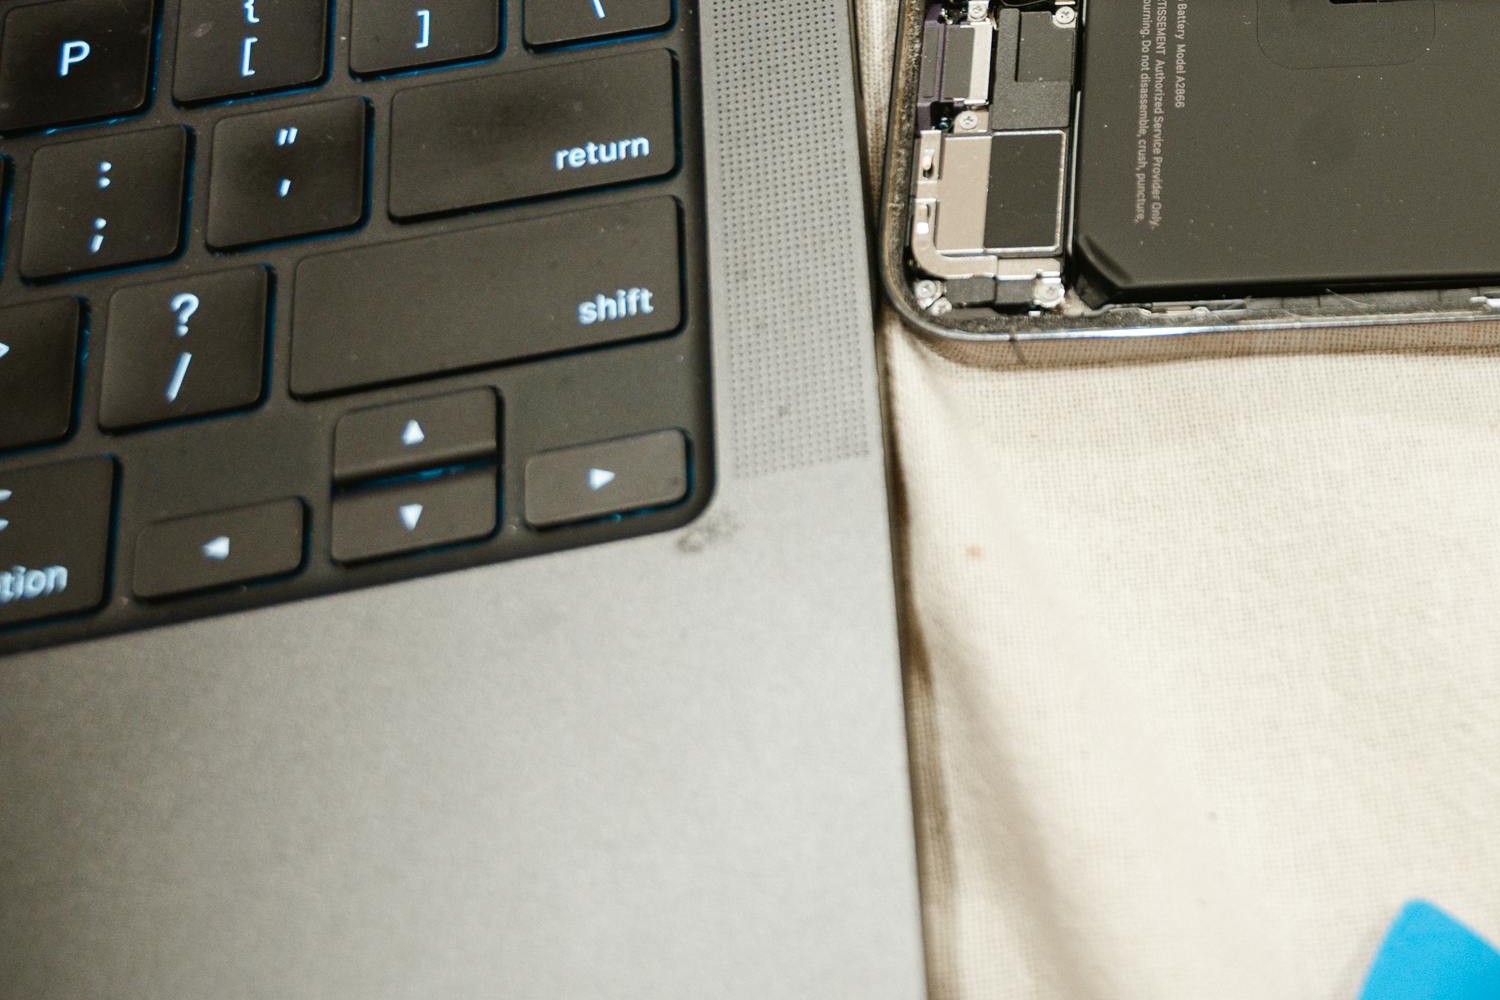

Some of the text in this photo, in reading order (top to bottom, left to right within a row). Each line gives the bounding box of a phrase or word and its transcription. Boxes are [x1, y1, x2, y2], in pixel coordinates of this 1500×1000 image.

[1174, 3, 1187, 40] Battery
[59, 40, 90, 77] P
[1140, 55, 1150, 71] not
[1141, 40, 1152, 53] Do
[1175, 44, 1187, 74] Model
[1154, 59, 1166, 114] Authorized
[1175, 75, 1186, 108] A2866
[1137, 73, 1151, 138] disassemble,
[555, 136, 651, 171] return
[1153, 116, 1164, 155] Service
[1136, 139, 1148, 171] crush,
[1152, 156, 1163, 200] Provider
[170, 292, 200, 337] ?
[577, 286, 655, 326] shift
